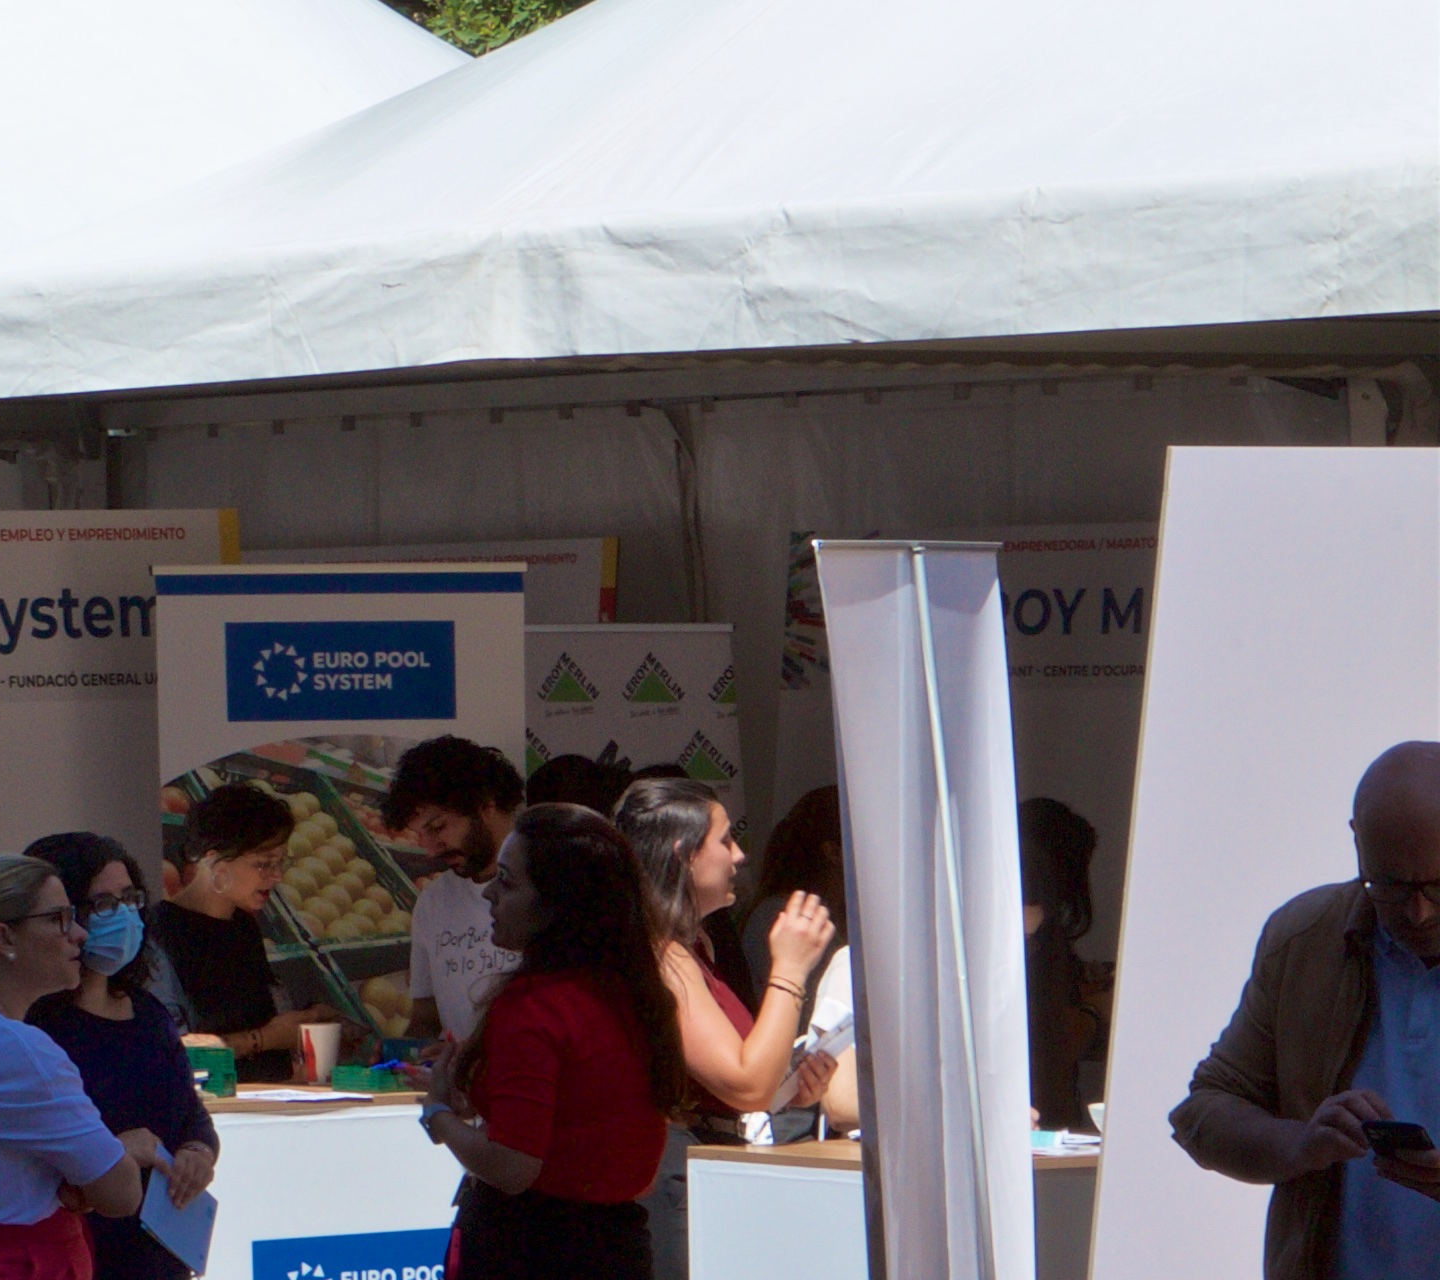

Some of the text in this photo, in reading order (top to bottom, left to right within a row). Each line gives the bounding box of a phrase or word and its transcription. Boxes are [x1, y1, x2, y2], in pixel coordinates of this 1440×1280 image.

[0, 528, 54, 542] EMPLEO
[56, 528, 66, 541] Y
[68, 526, 186, 542] EMPRENDIMIENTO
[1001, 587, 1087, 636] OY
[312, 651, 431, 669] EURO POOL
[536, 651, 601, 702] LEROY MERLIN
[621, 651, 687, 702] LEROY MERLIN
[8, 671, 78, 689] FUNDACIÓ
[81, 672, 142, 687] GENERAL
[313, 673, 393, 691] SYSTEM
[694, 730, 739, 780] MERLIN
